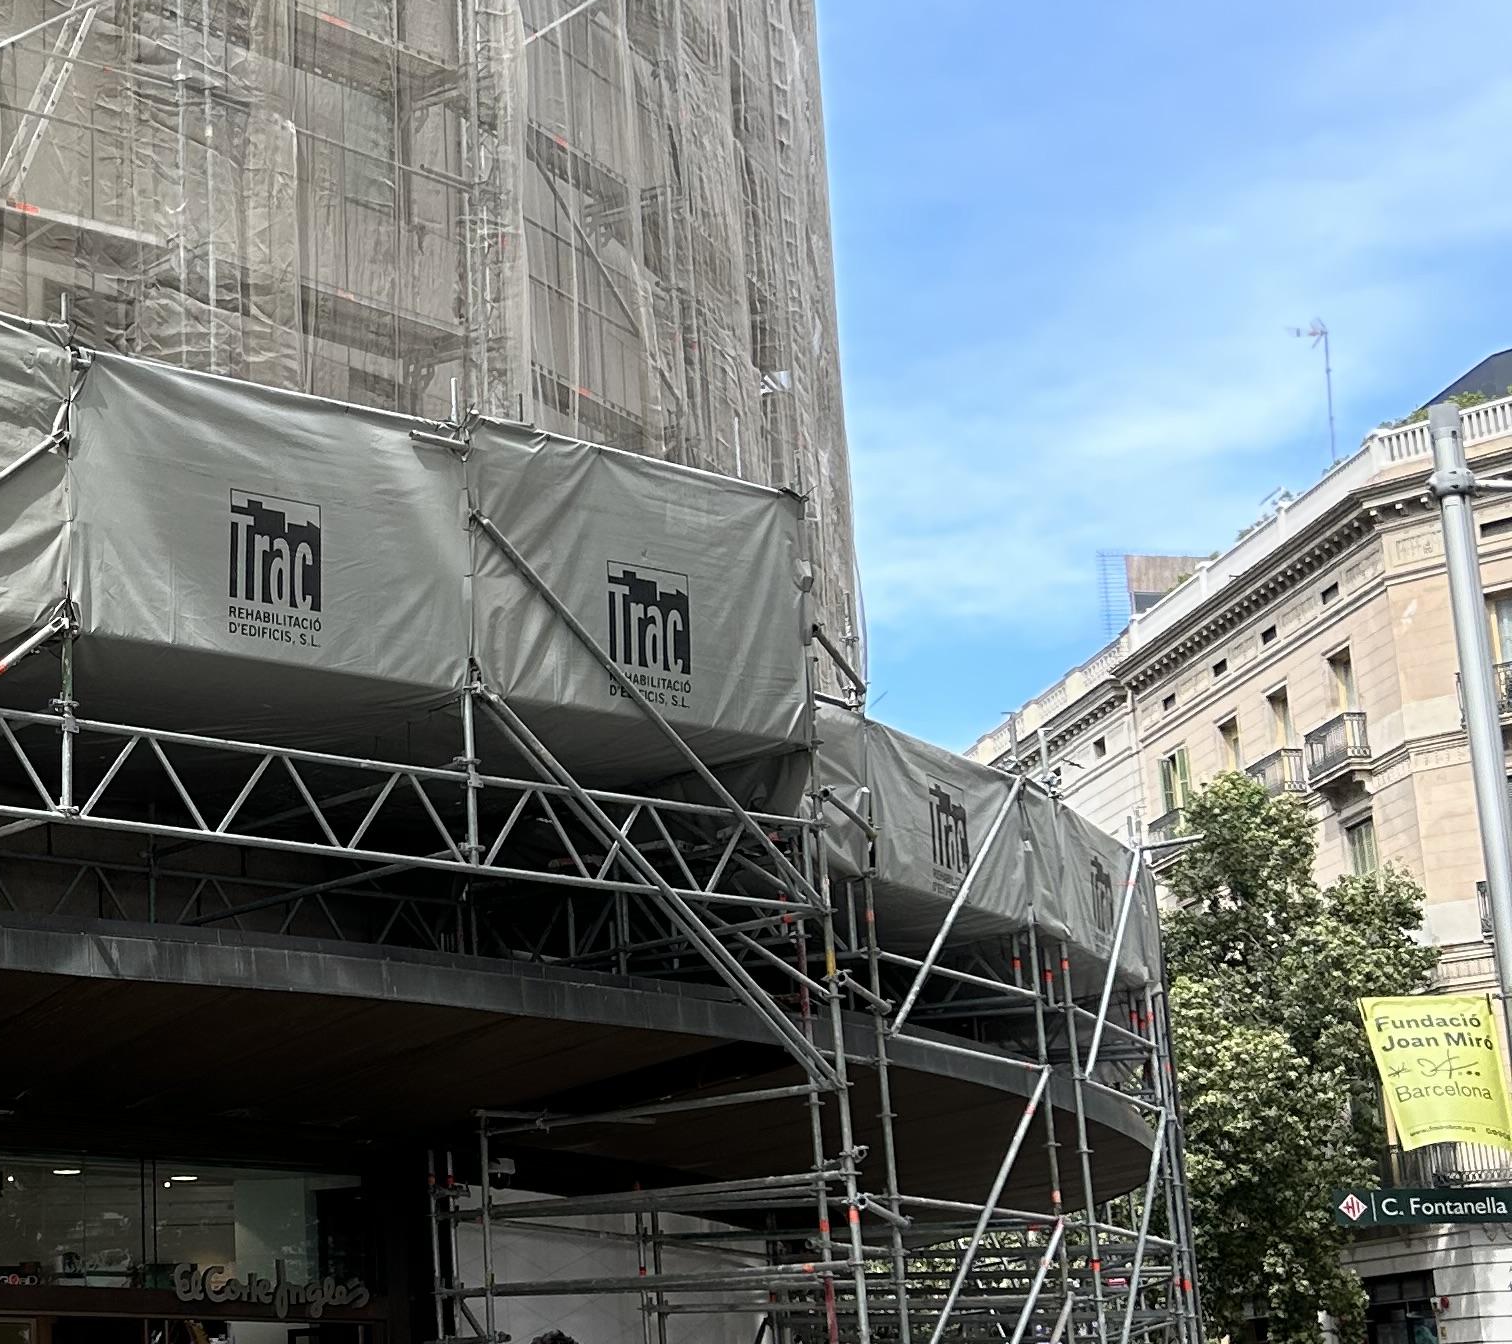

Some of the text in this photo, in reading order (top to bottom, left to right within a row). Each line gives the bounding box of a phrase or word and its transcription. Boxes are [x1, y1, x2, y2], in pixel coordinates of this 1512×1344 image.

[229, 511, 314, 611] Trac
[228, 605, 322, 632] REHABILITACIÓ
[606, 582, 685, 674] Trac
[228, 621, 322, 648] D'EDIFICIS, S.L.
[609, 671, 692, 694] HABILITACIÓ
[1374, 1013, 1482, 1033] Fundació
[1381, 1032, 1494, 1052] Joan Miró
[1395, 1081, 1494, 1104] Barcelona
[1381, 1196, 1508, 1216] C. Fontanella
[174, 1263, 205, 1302] El
[205, 1265, 273, 1303] Corte
